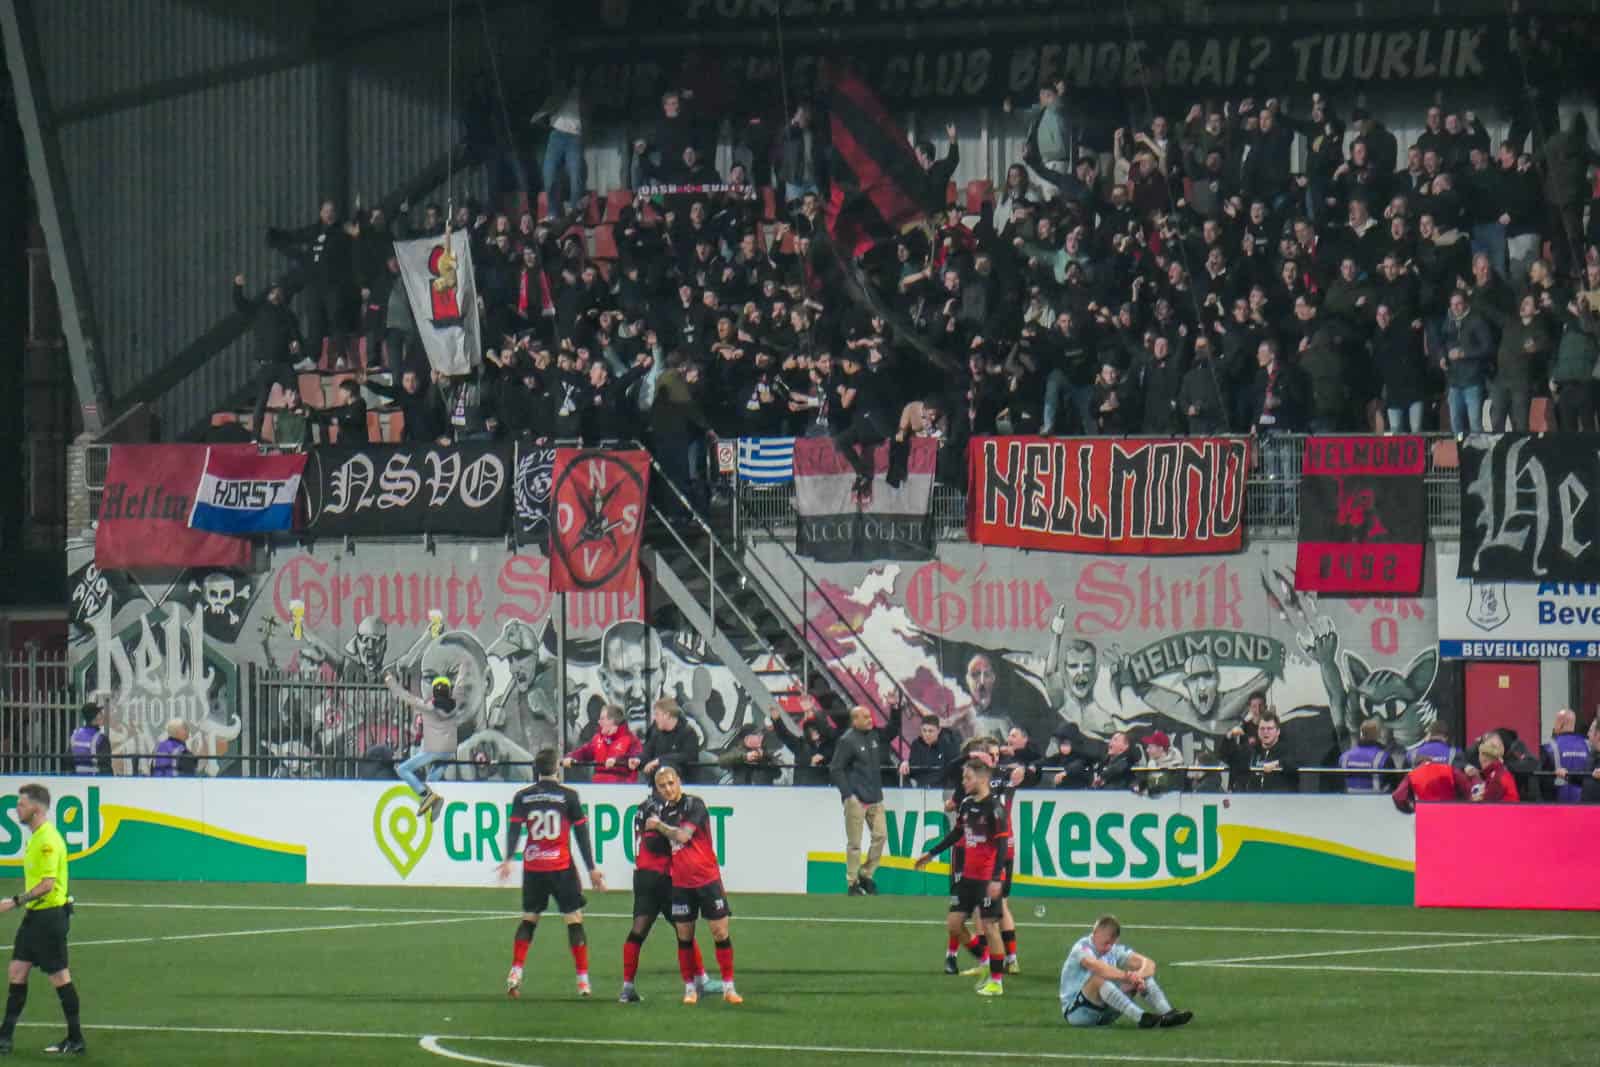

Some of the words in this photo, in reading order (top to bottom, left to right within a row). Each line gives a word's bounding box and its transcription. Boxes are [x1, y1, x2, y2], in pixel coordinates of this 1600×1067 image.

[1292, 23, 1487, 81] TUURLIK
[322, 452, 506, 515] NSVO
[1306, 440, 1419, 469] HELMOND
[212, 478, 287, 510] HORST
[983, 439, 1246, 541] HELLMOND
[1462, 433, 1600, 576] He
[1319, 553, 1398, 581] 0492
[1131, 633, 1273, 683] HELLMOND
[1462, 642, 1570, 657] BEVEILIGING
[1587, 642, 1600, 657] S
[0, 786, 100, 857] sel
[444, 800, 734, 866] GREPT
[527, 808, 561, 841] 20
[885, 809, 952, 860] va
[1018, 800, 1220, 879] Kessel
